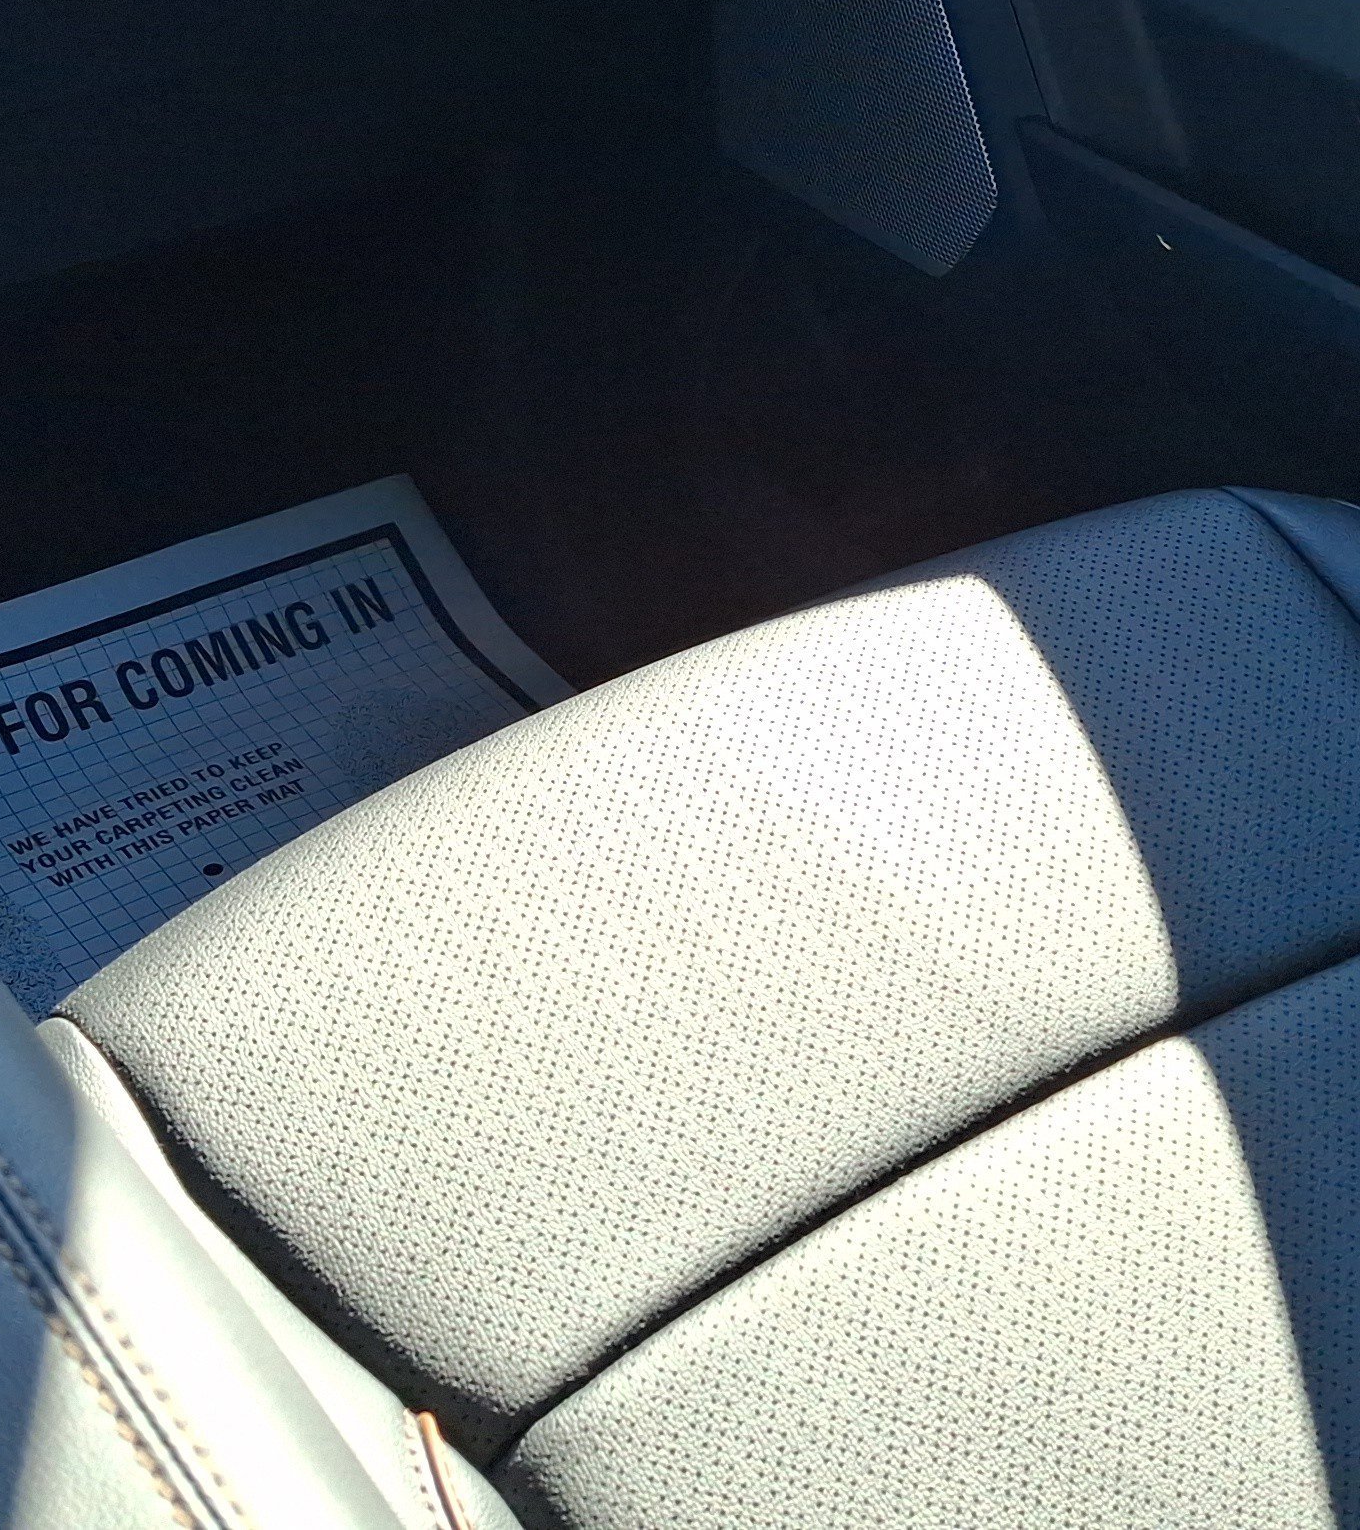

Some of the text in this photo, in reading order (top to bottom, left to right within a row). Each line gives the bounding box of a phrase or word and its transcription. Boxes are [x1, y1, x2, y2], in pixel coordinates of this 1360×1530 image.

[115, 600, 330, 712] COMING
[327, 578, 396, 635] IN
[7, 742, 283, 856] WE HAVE TRIED TO KEEP
[19, 758, 304, 874] YOUR CARPETING CLEAN
[47, 778, 306, 888] WITH THIS PAPER MAT
